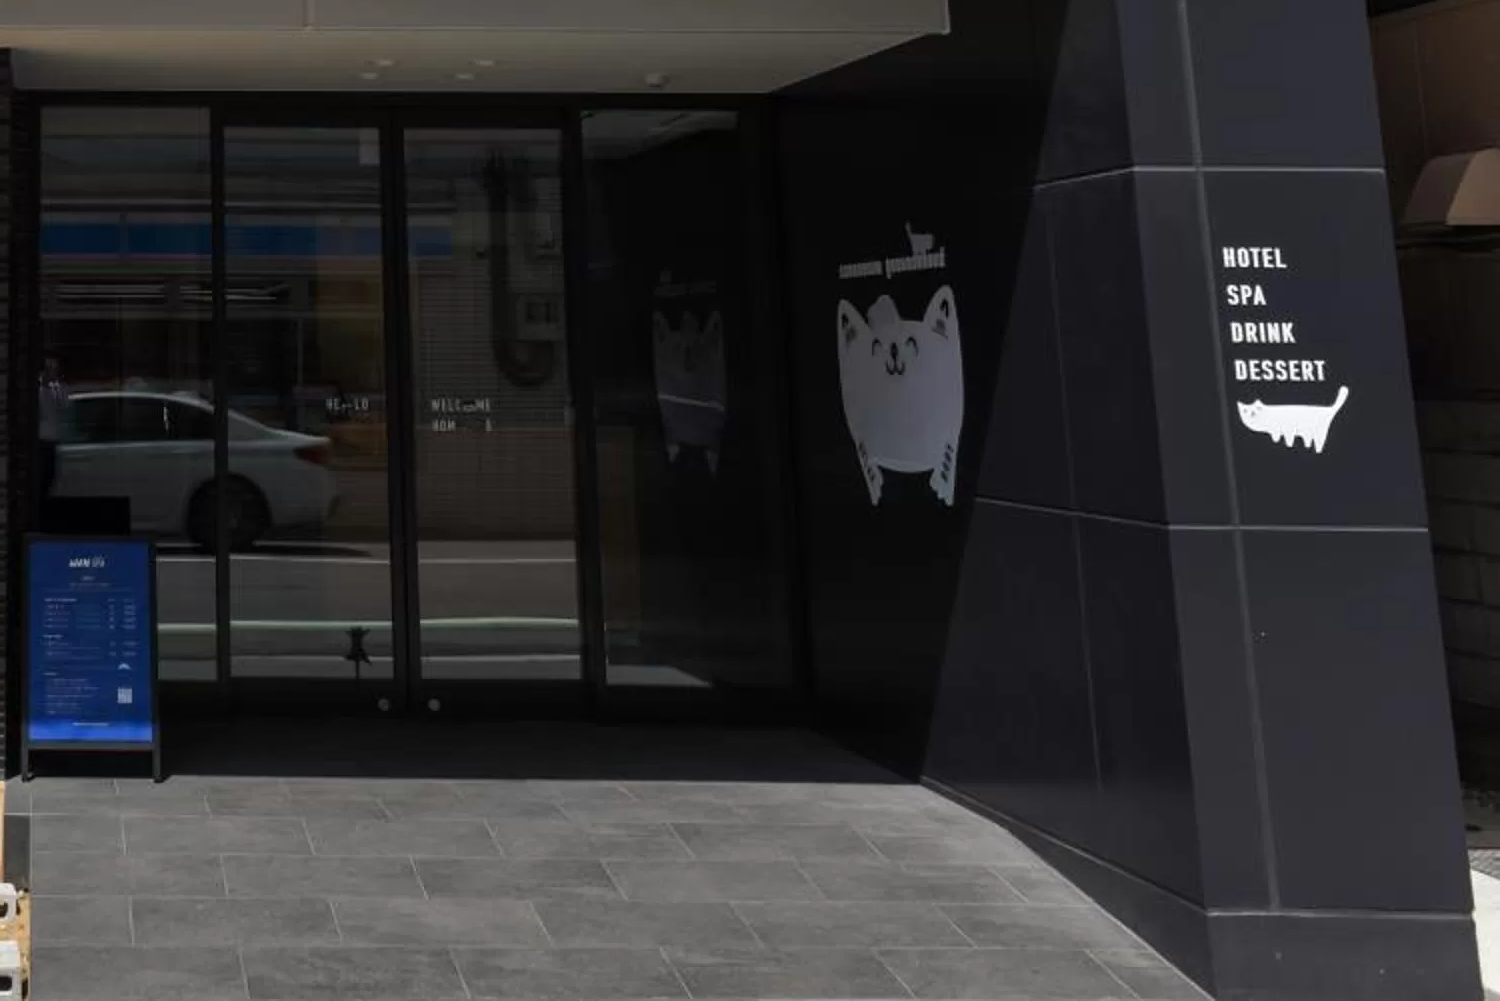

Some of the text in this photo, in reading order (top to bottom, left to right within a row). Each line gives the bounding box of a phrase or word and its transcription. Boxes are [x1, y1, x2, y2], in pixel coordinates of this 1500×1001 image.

[1222, 247, 1287, 269] HOTEL
[1226, 284, 1267, 306] SPA
[1230, 321, 1296, 344] DRINK
[1234, 359, 1326, 382] DESSERT
